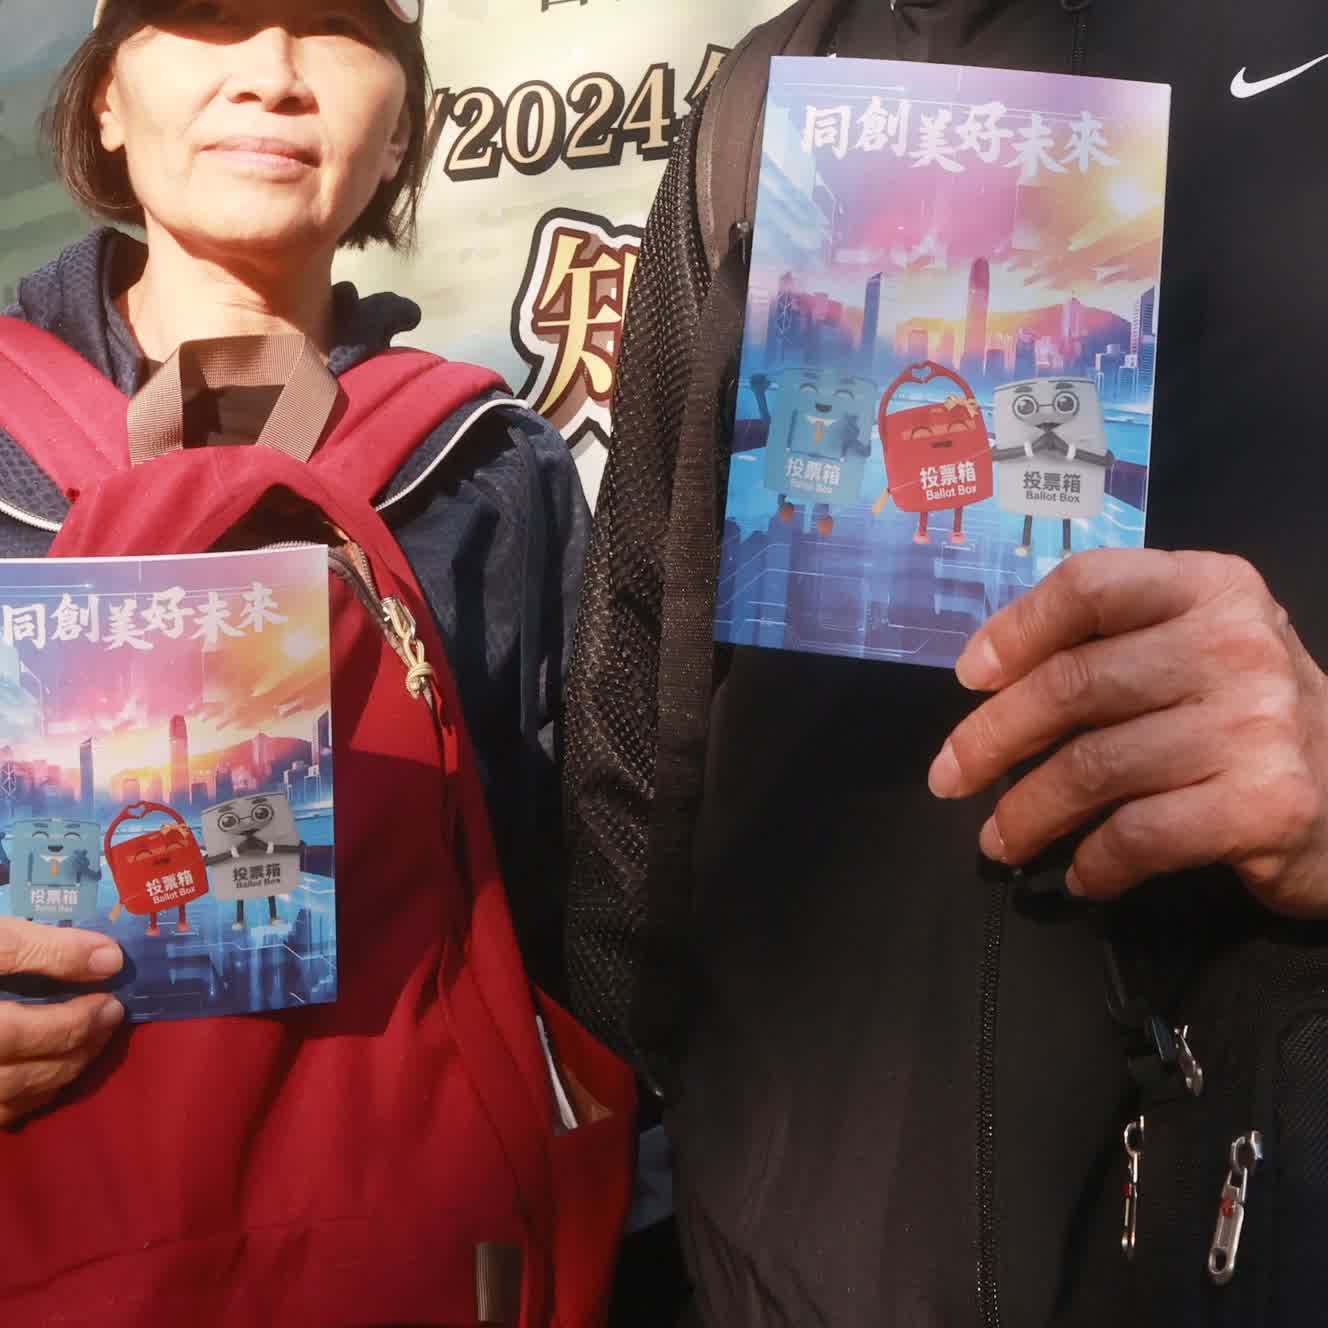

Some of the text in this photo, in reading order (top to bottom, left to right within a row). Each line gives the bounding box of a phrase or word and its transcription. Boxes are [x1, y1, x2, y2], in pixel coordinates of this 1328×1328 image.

[800, 94, 1121, 176] 同創美好未來
[920, 461, 976, 490] 投票箱
[1023, 471, 1081, 494] 投票箱
[926, 483, 977, 501] Ballot Box
[1025, 490, 1081, 503] Ballot Box
[1, 582, 289, 652] 同創美好未來
[145, 870, 194, 896] 投票箱
[232, 863, 281, 883] 投票箱
[152, 886, 196, 905] Ballot Box
